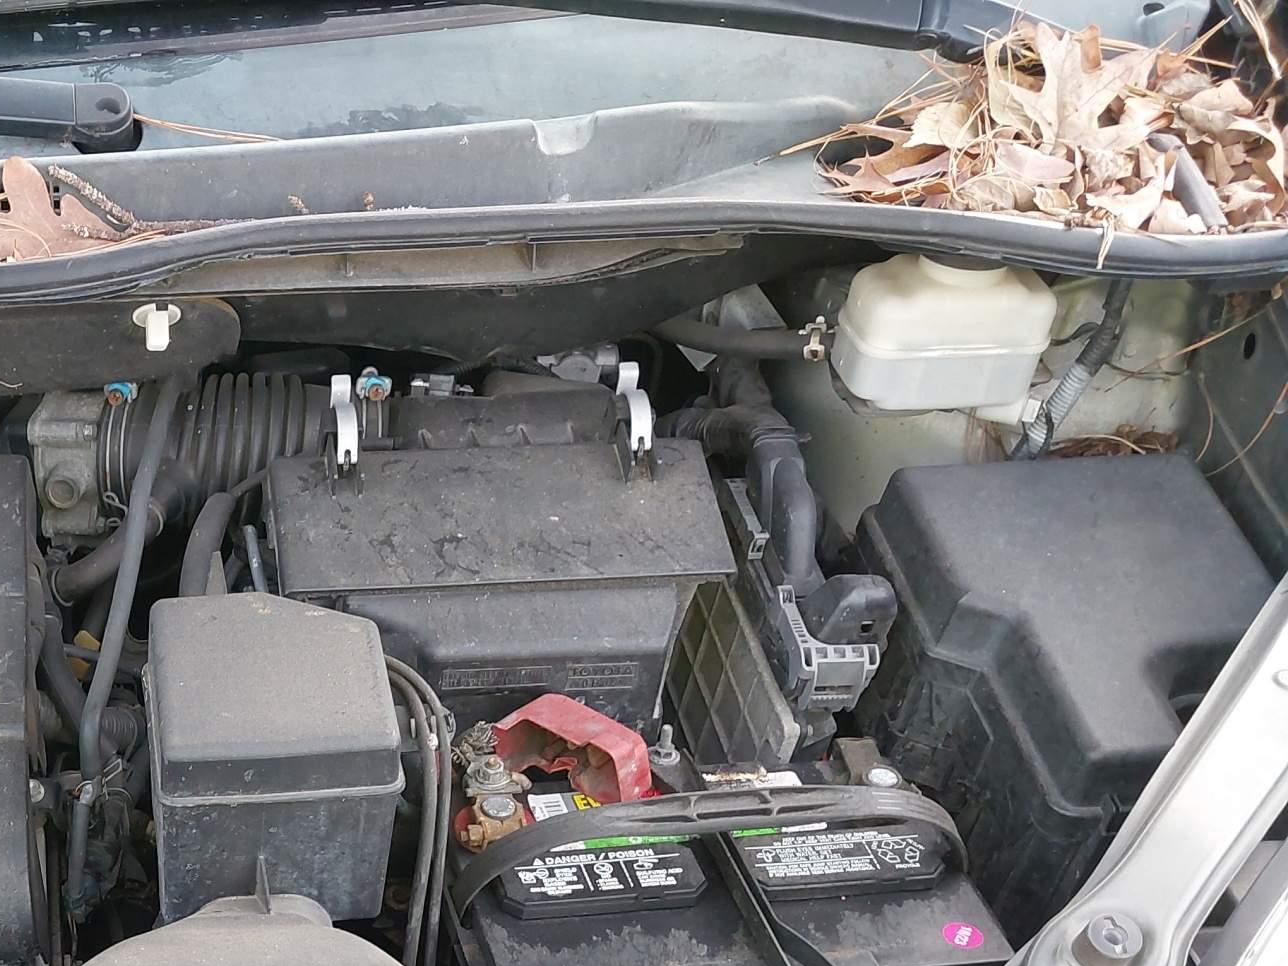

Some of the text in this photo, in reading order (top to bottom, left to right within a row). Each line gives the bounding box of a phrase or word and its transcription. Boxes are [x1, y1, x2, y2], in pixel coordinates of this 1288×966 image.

[545, 848, 654, 865] DANGER / POISON
